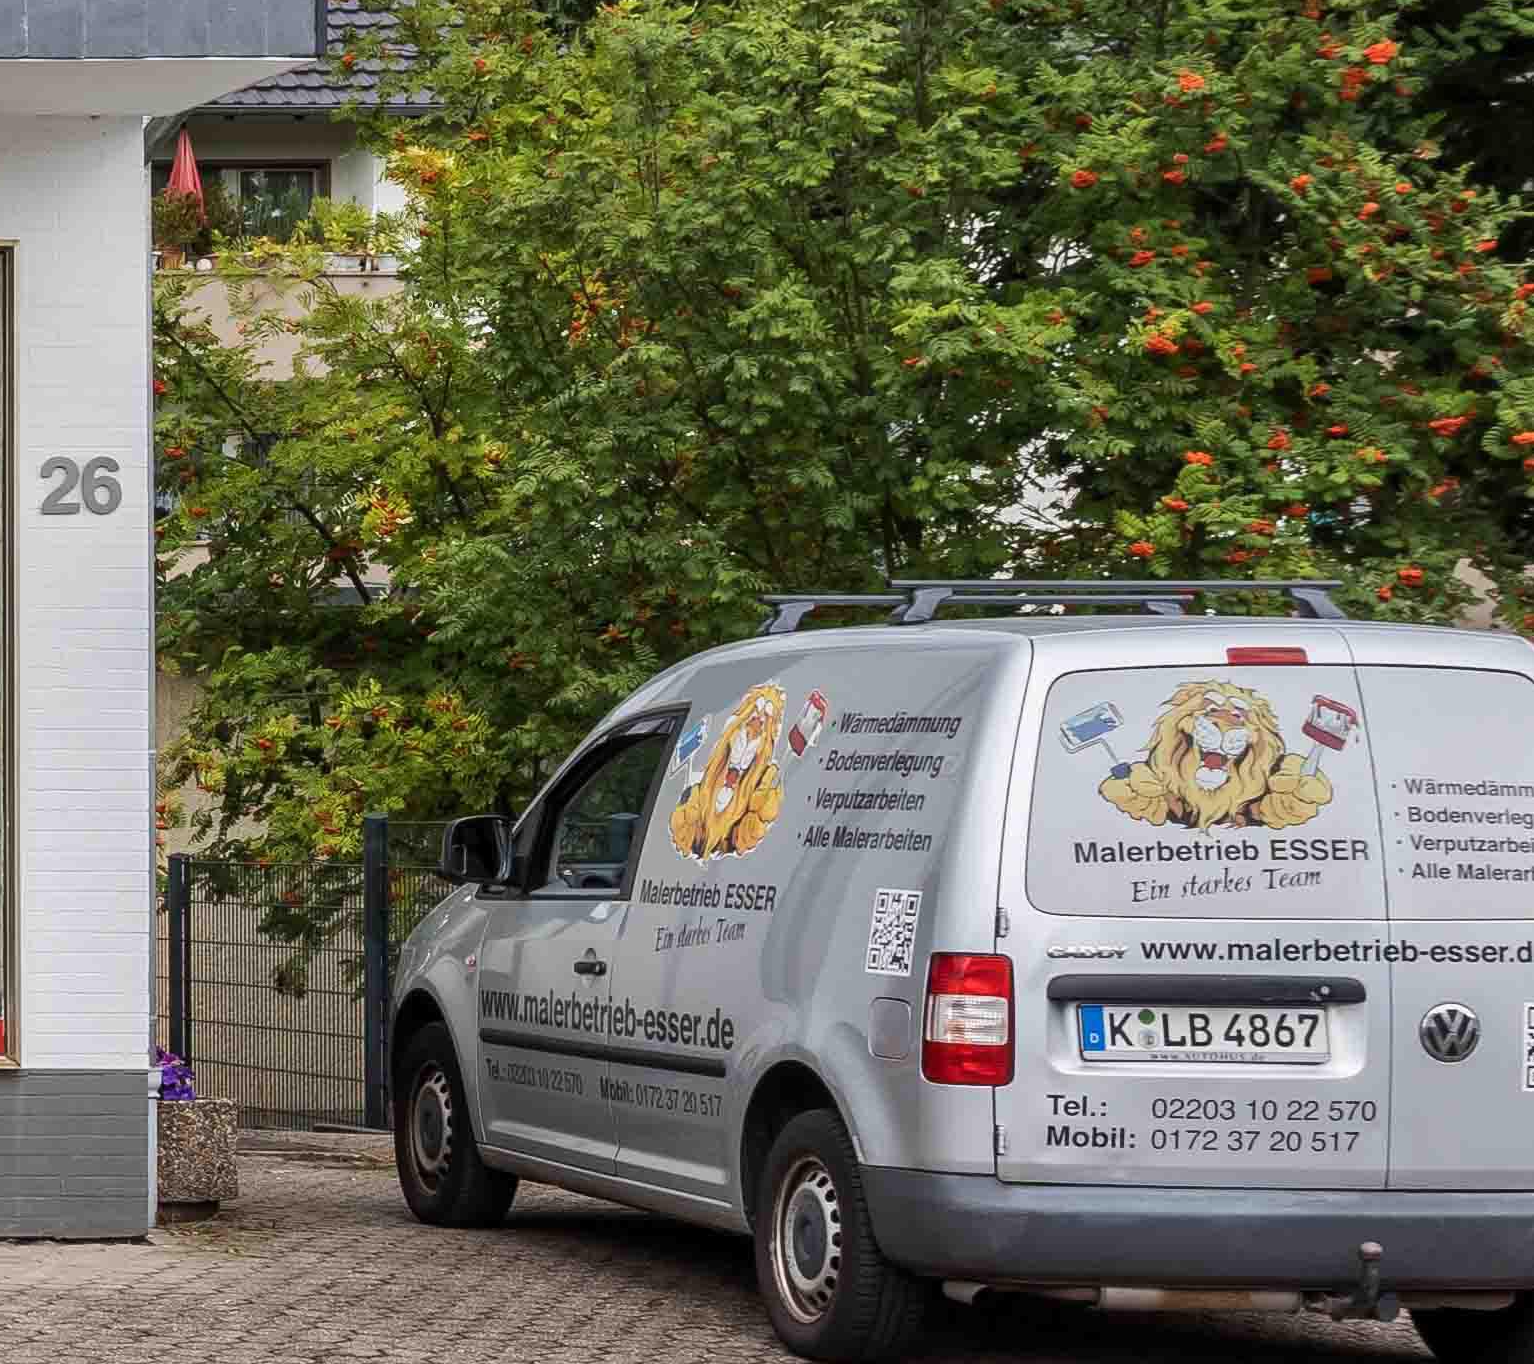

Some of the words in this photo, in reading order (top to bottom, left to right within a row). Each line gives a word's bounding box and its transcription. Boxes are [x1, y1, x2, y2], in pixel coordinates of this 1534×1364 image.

[39, 456, 122, 516] 26
[840, 711, 962, 739] Wärmedämmung
[826, 749, 945, 778] Bodenverlegung
[814, 788, 925, 815] Verputzarbeiten
[803, 825, 830, 848] Alle
[832, 825, 933, 852] Malerarbeiten
[1074, 839, 1259, 863] Malerbetrieb
[1270, 838, 1369, 861] ESSER
[1131, 880, 1170, 903] Ein
[1180, 867, 1253, 898] starkes
[1261, 867, 1321, 890] Team
[1412, 863, 1451, 879] Alle
[640, 878, 721, 908] Malerbetrieb
[724, 883, 777, 912] ESSER
[480, 988, 735, 1050] www.malerbetrieb-esser.de
[1108, 1012, 1133, 1047] K
[1161, 1012, 1213, 1048] LB
[1224, 1013, 1320, 1048] 4867
[599, 1075, 635, 1105] Mobil:
[636, 1083, 664, 1109] 0172
[665, 1088, 679, 1111] 37
[683, 1091, 698, 1114] 20
[699, 1094, 722, 1117] 517
[1046, 1094, 1107, 1117] Tel.:
[1152, 1098, 1235, 1121] 02203
[1247, 1099, 1277, 1121] 10
[1287, 1100, 1319, 1122] 22
[1328, 1100, 1377, 1122] 570
[1046, 1125, 1136, 1148] Mobil:
[1151, 1129, 1218, 1151] 0172
[1227, 1130, 1260, 1151] 37
[1269, 1131, 1301, 1152] 20
[1311, 1131, 1360, 1152] 517
